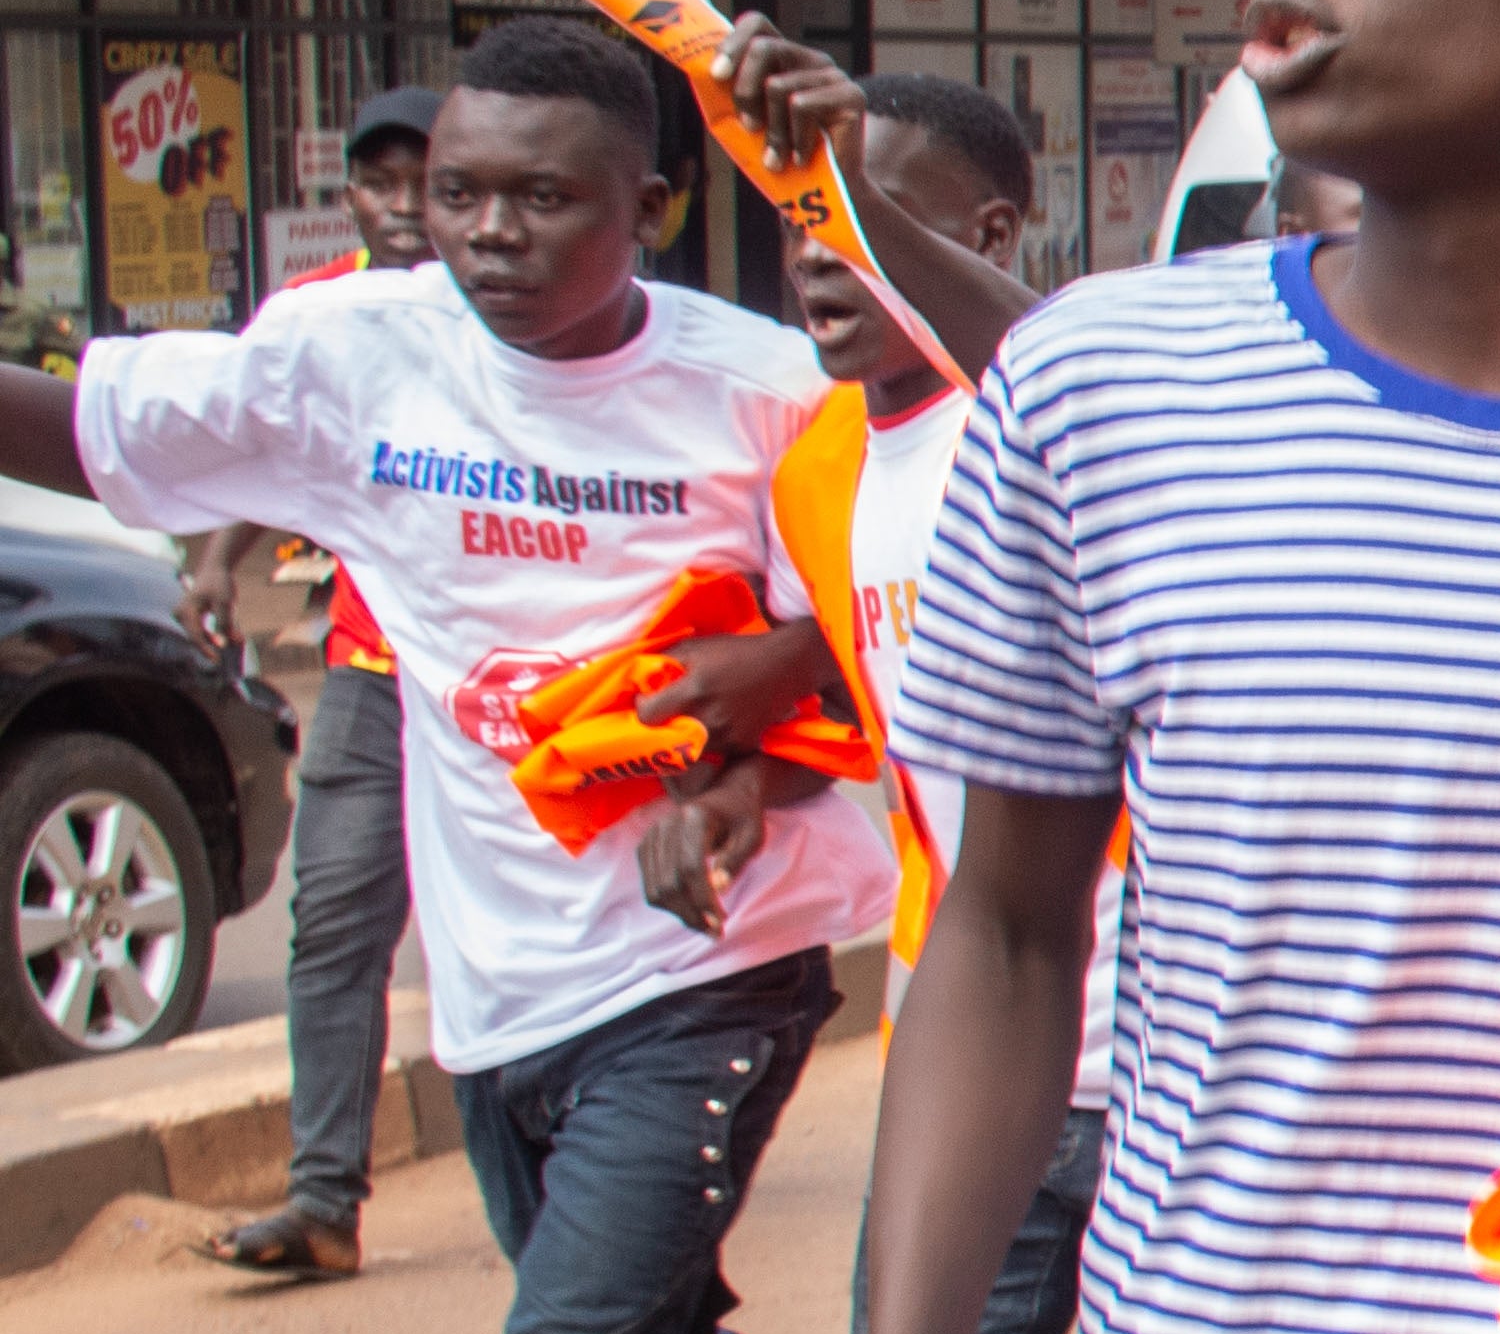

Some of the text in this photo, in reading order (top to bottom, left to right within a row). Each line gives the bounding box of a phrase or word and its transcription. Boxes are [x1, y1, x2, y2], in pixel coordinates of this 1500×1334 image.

[111, 66, 198, 169] 50%
[159, 125, 235, 198] OFF
[371, 440, 690, 516] Activists Against
[461, 510, 589, 563] EACOP
